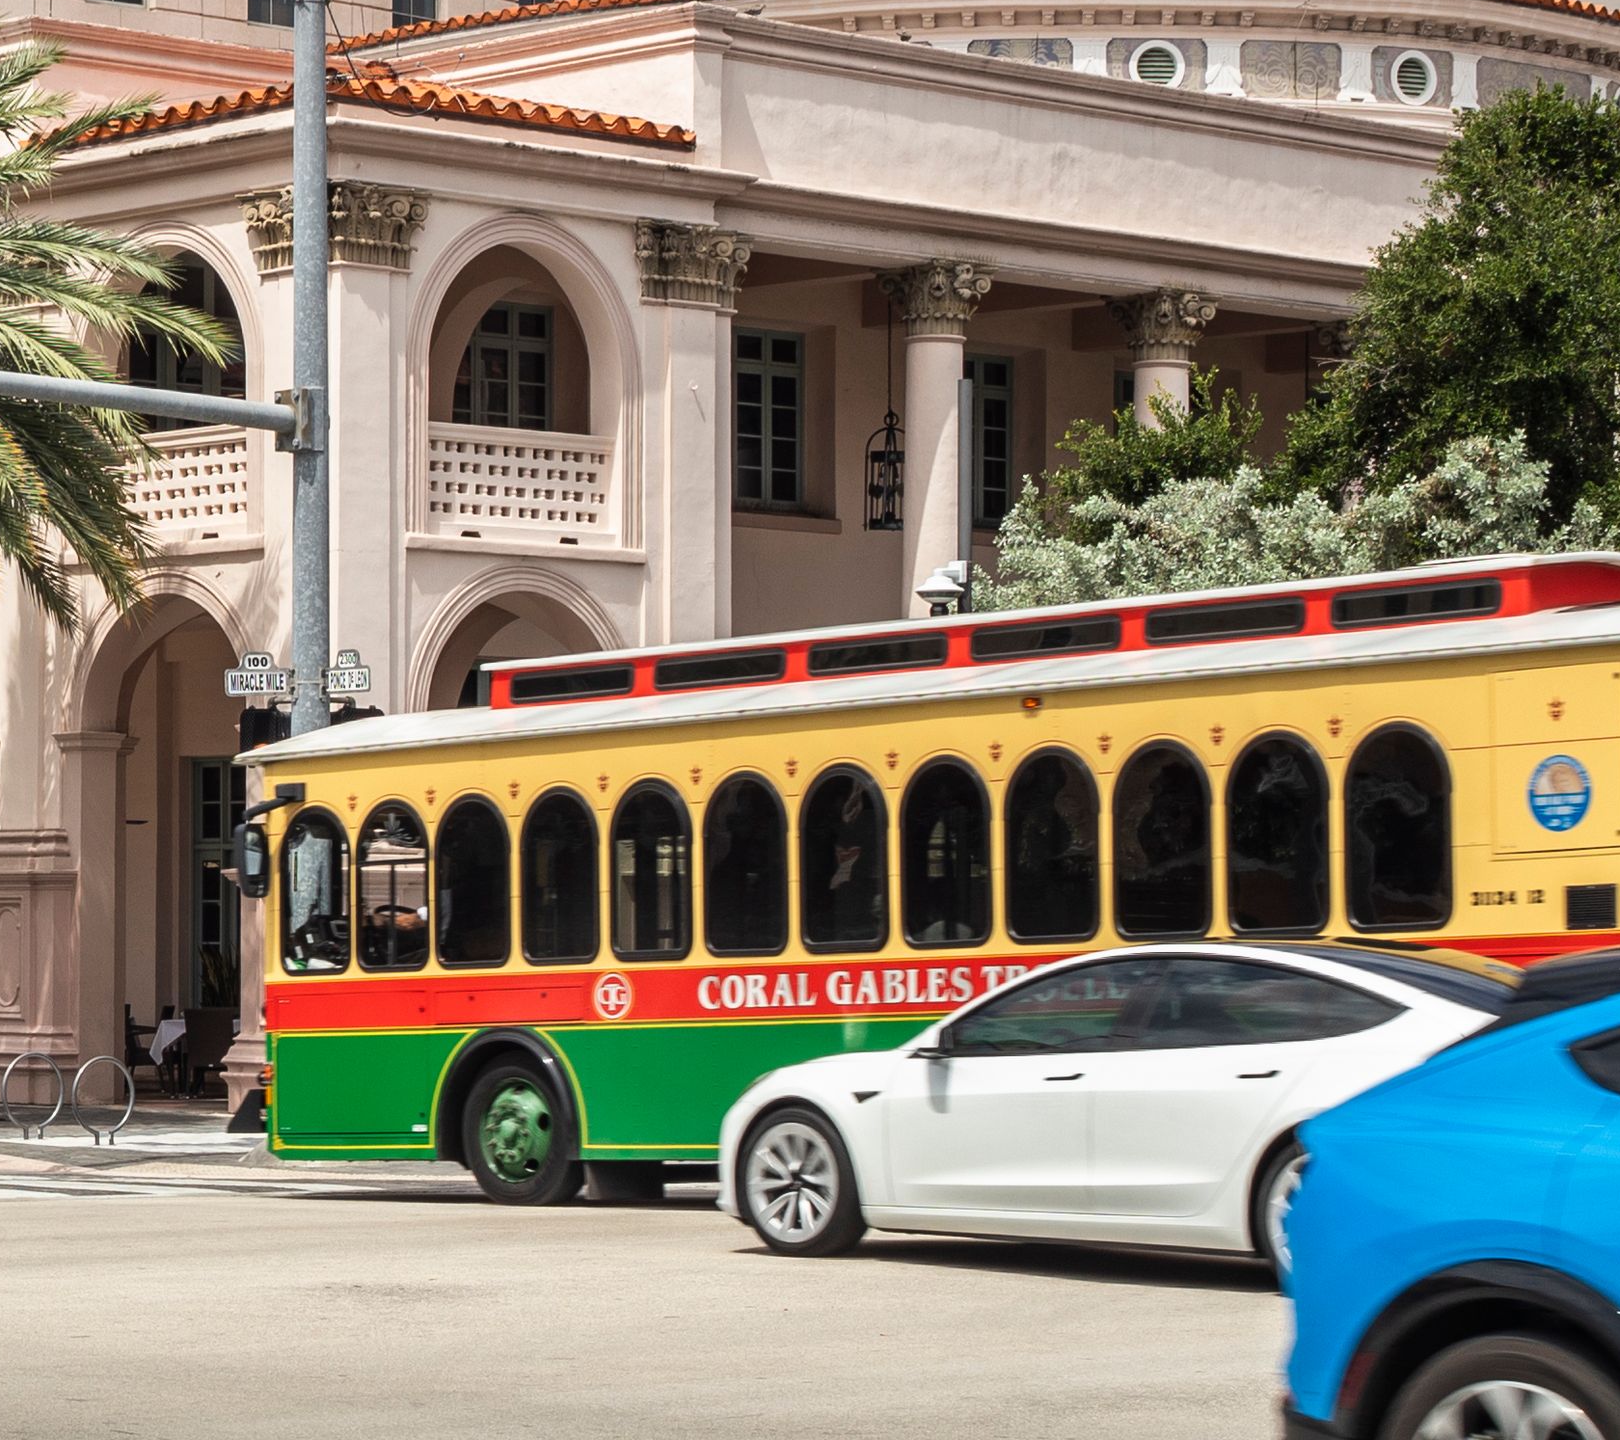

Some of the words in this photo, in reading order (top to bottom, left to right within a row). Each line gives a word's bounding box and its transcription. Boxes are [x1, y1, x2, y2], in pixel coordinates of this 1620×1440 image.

[247, 657, 268, 667] 100
[230, 674, 264, 691] MIRACLE
[266, 673, 284, 690] MILE
[697, 972, 817, 1010] CORAL
[826, 965, 974, 1007] GABLES
